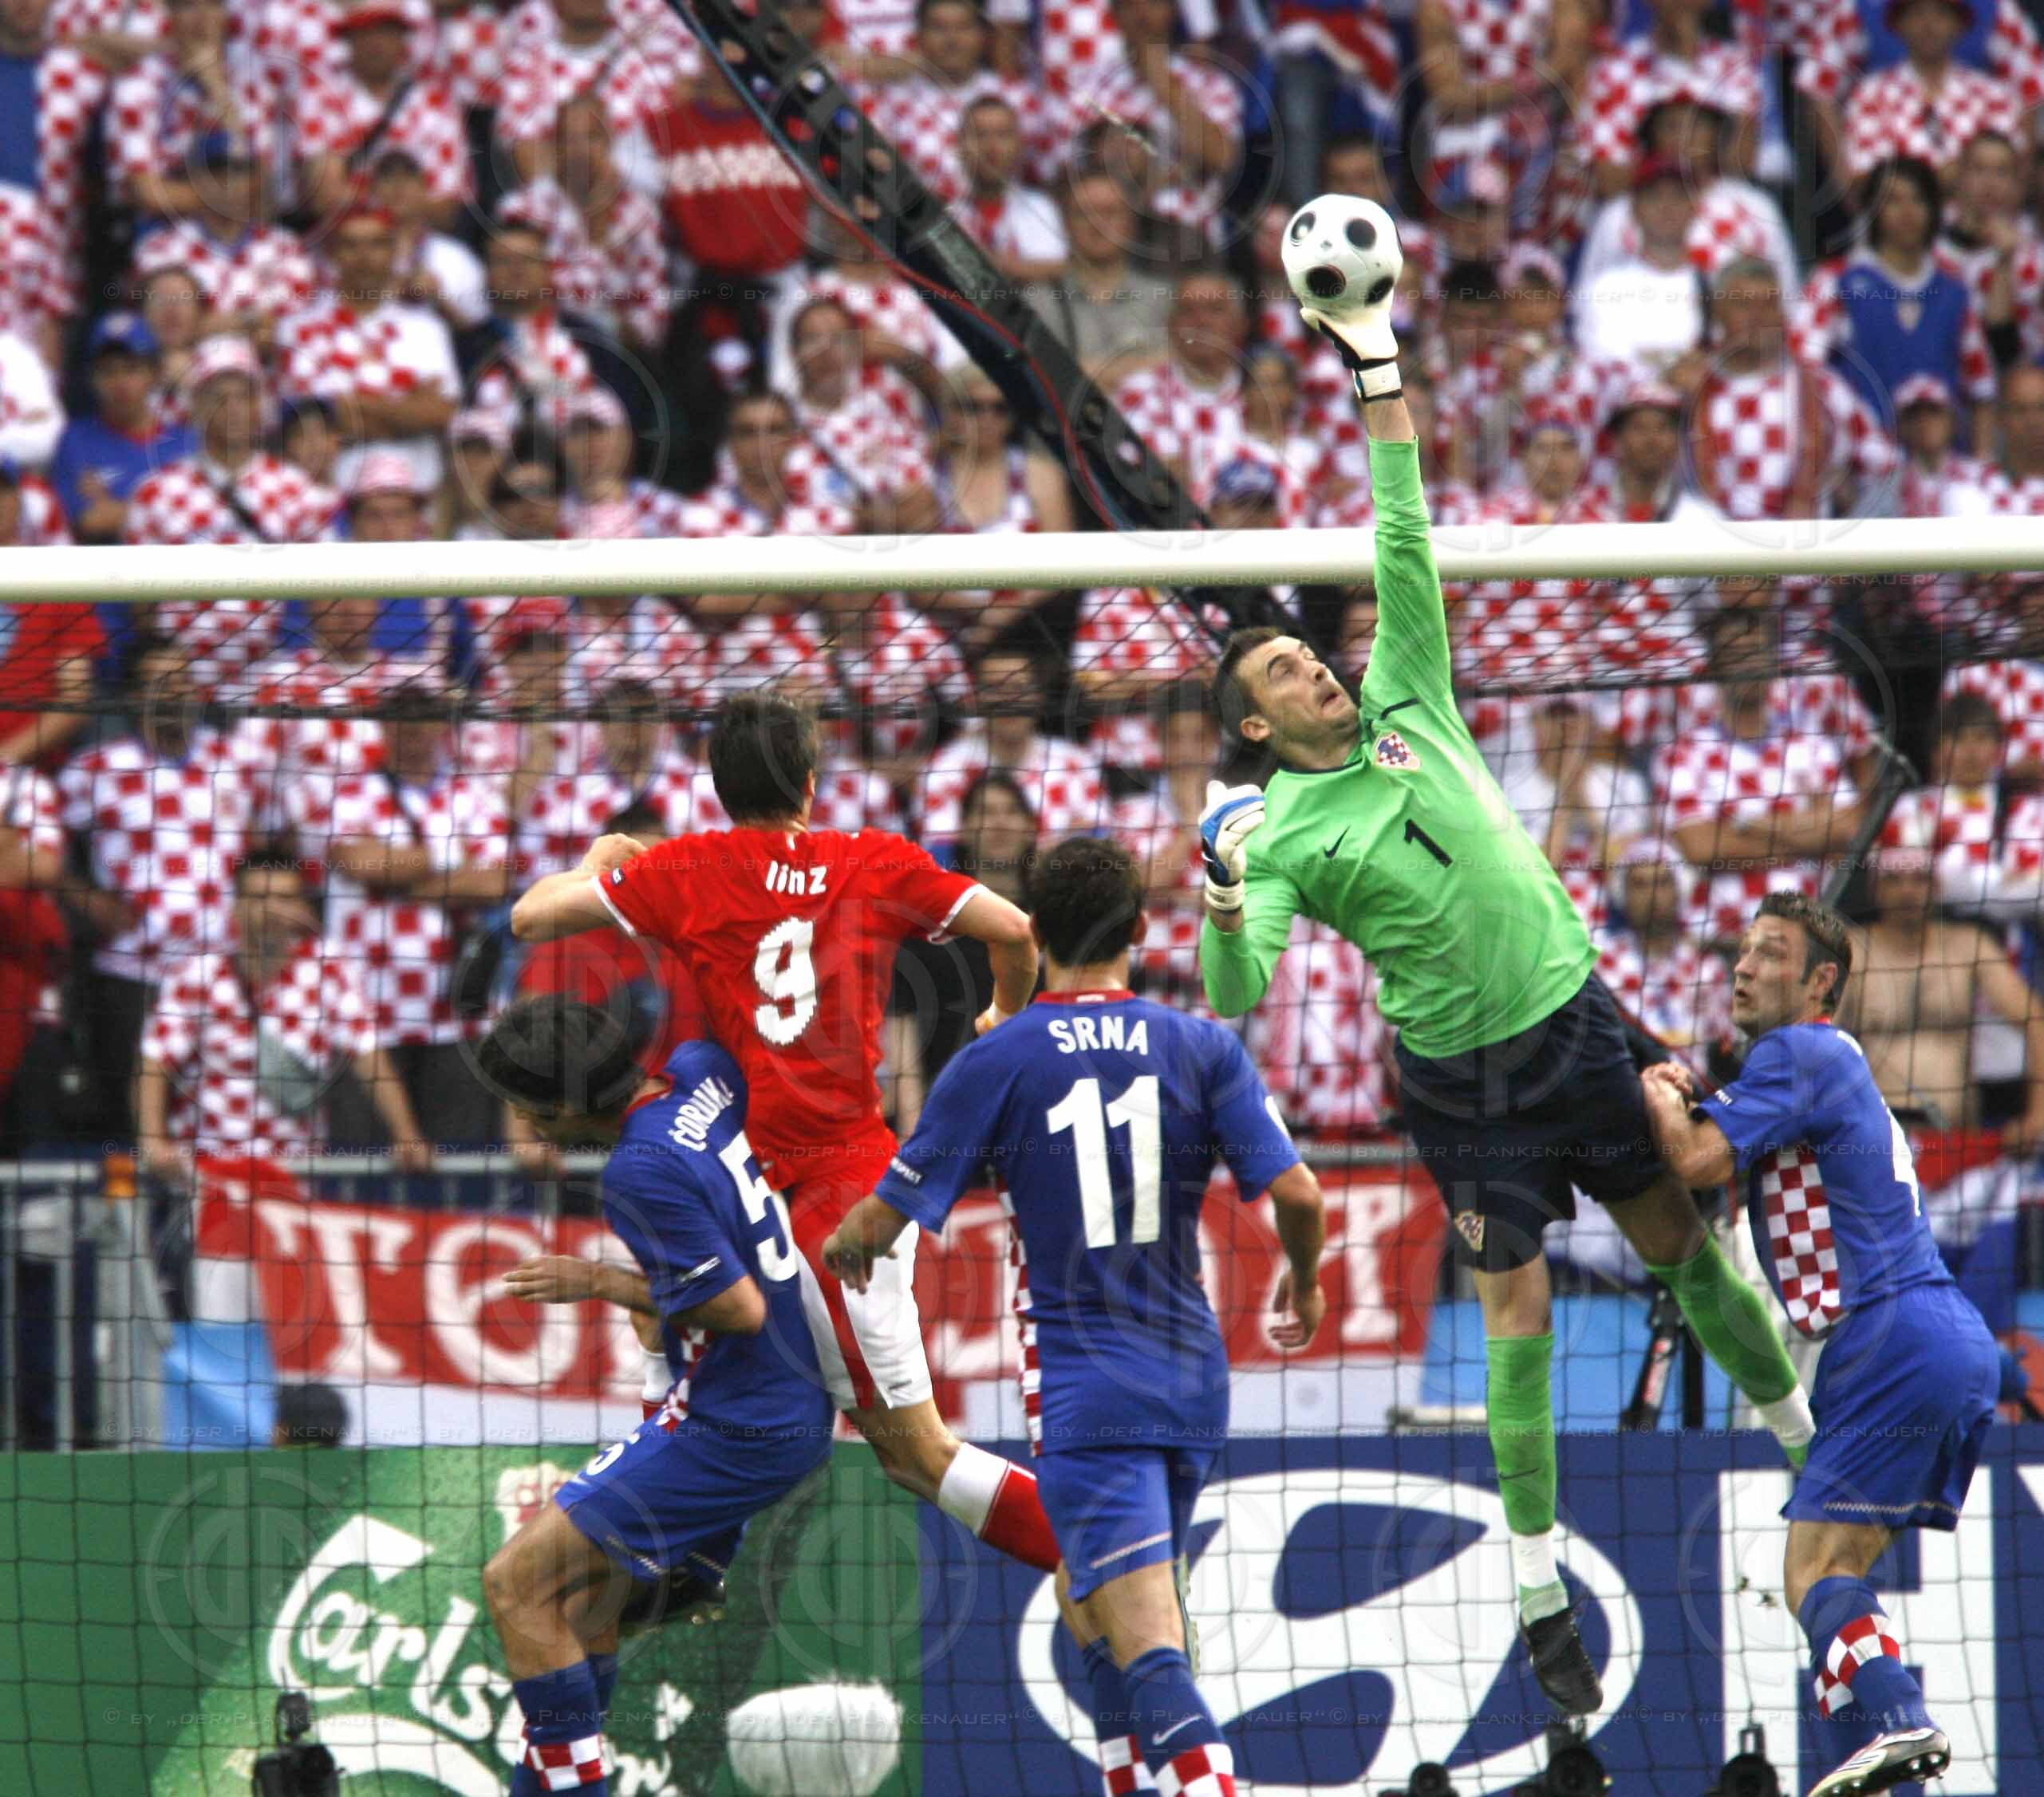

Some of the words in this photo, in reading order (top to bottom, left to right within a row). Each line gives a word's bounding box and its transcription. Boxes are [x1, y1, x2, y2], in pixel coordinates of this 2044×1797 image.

[1404, 818, 1453, 868] 1
[754, 916, 818, 1046] 9
[1048, 1015, 1149, 1055] SRNA
[718, 1130, 799, 1283] 5
[1047, 1075, 1162, 1249] 11
